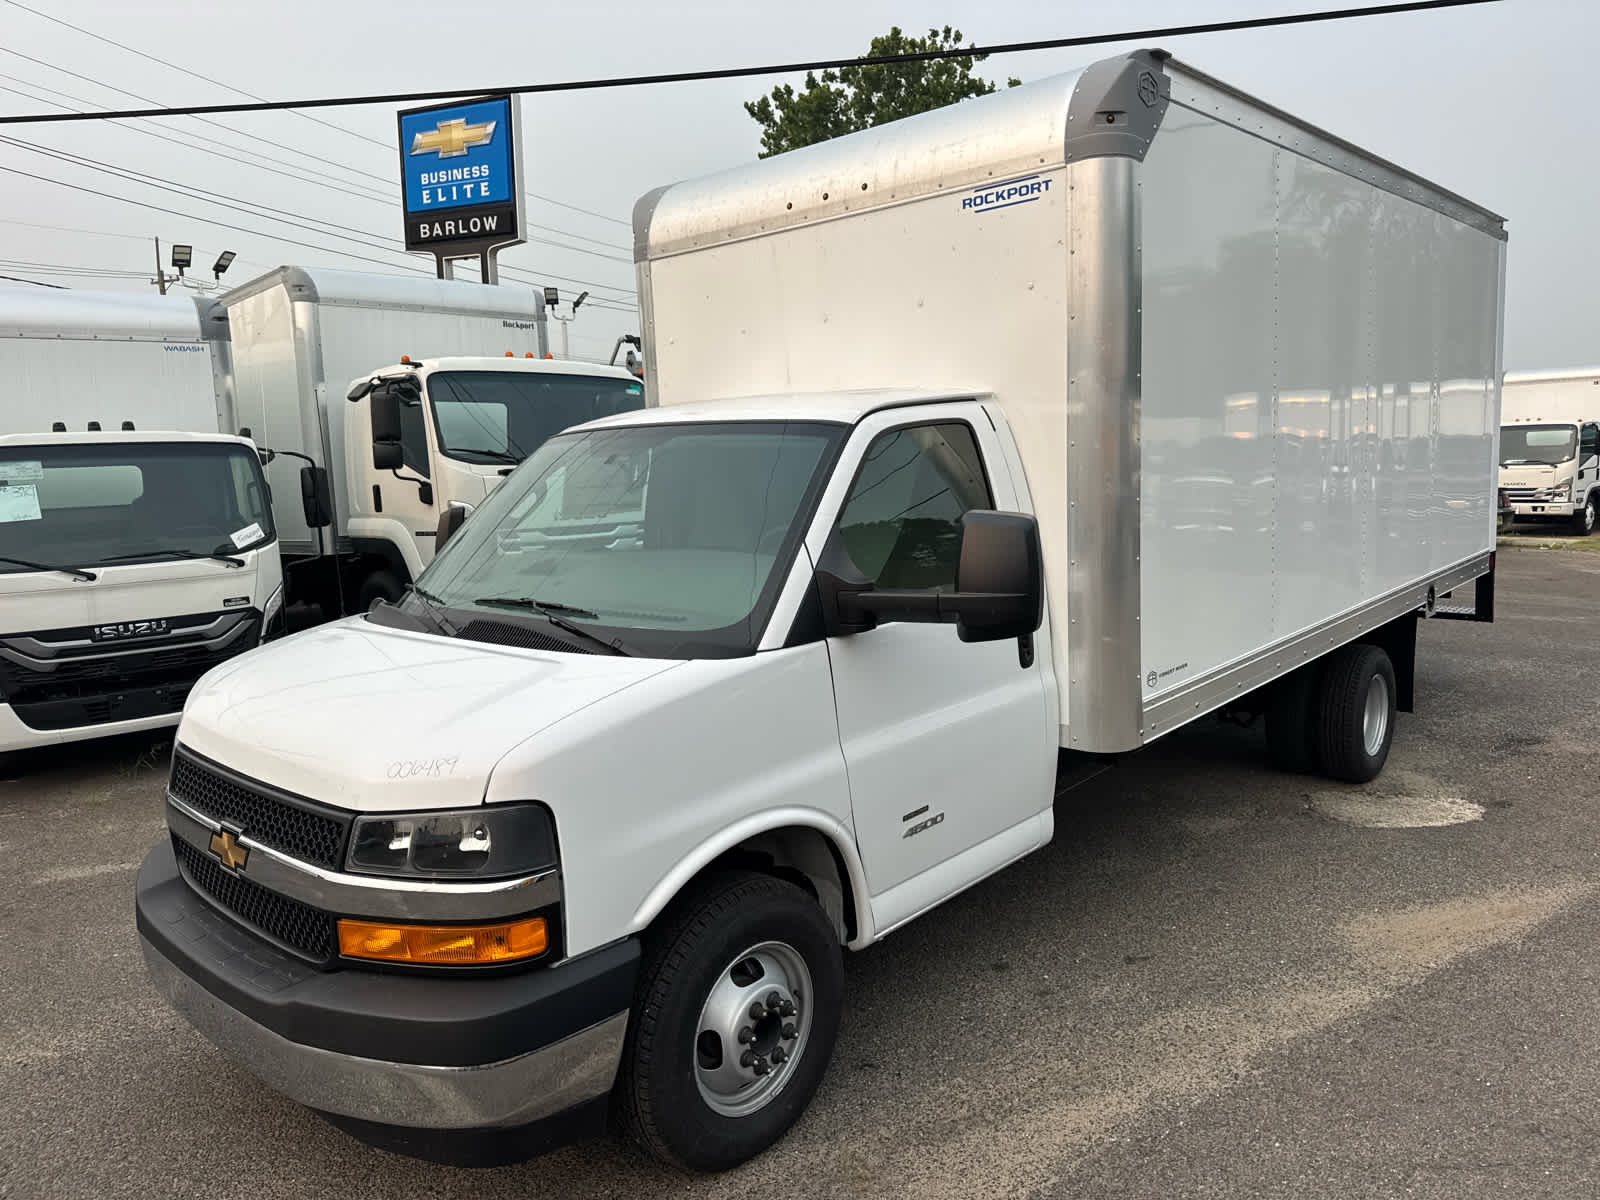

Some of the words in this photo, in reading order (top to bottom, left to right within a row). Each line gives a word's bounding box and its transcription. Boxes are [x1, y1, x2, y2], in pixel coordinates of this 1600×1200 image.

[420, 164, 490, 185] BUSINESS
[422, 181, 490, 204] ELITE
[962, 178, 1052, 210] ROCKPORT
[420, 215, 498, 238] BARLOW
[94, 620, 167, 640] ISUZU
[903, 812, 945, 839] 4500
